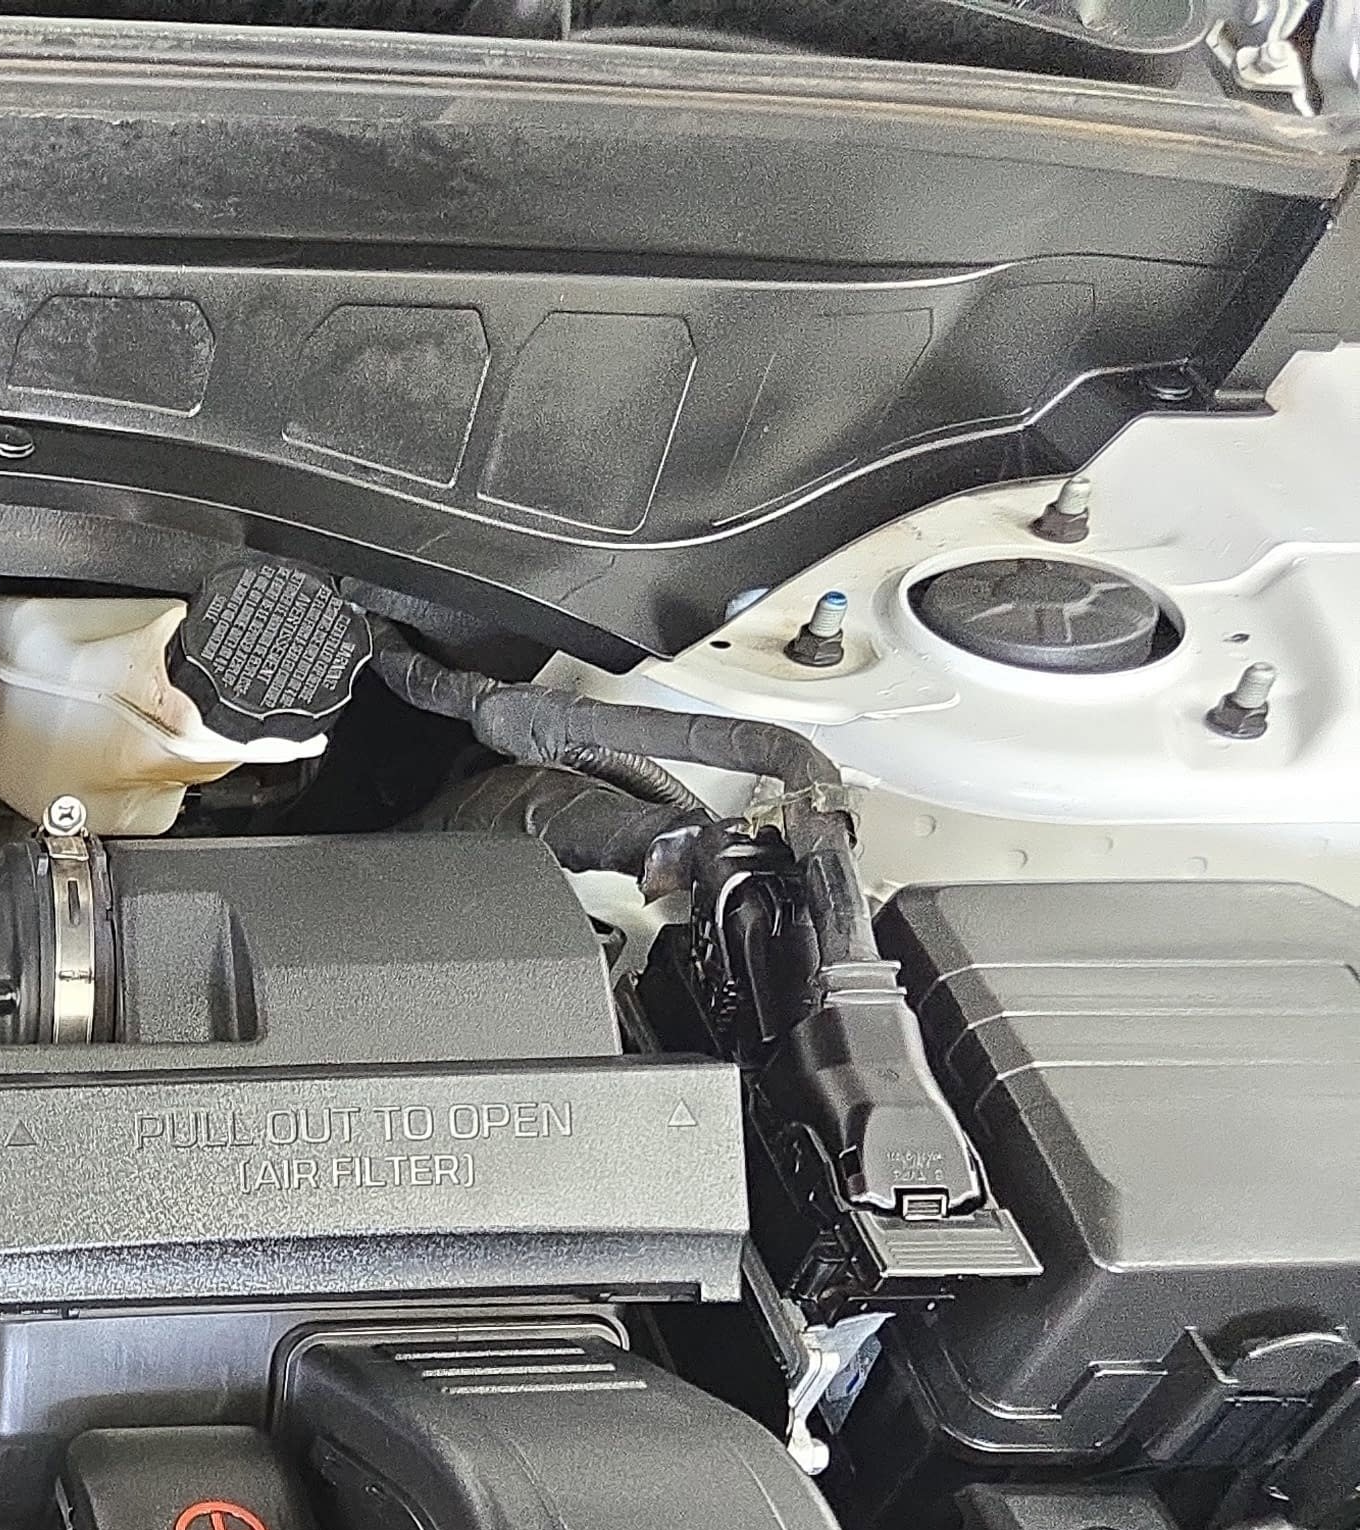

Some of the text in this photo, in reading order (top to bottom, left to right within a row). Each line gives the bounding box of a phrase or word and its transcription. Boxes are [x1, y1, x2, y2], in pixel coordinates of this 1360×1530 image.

[133, 1101, 573, 1150] PULL OUT TO OPEN
